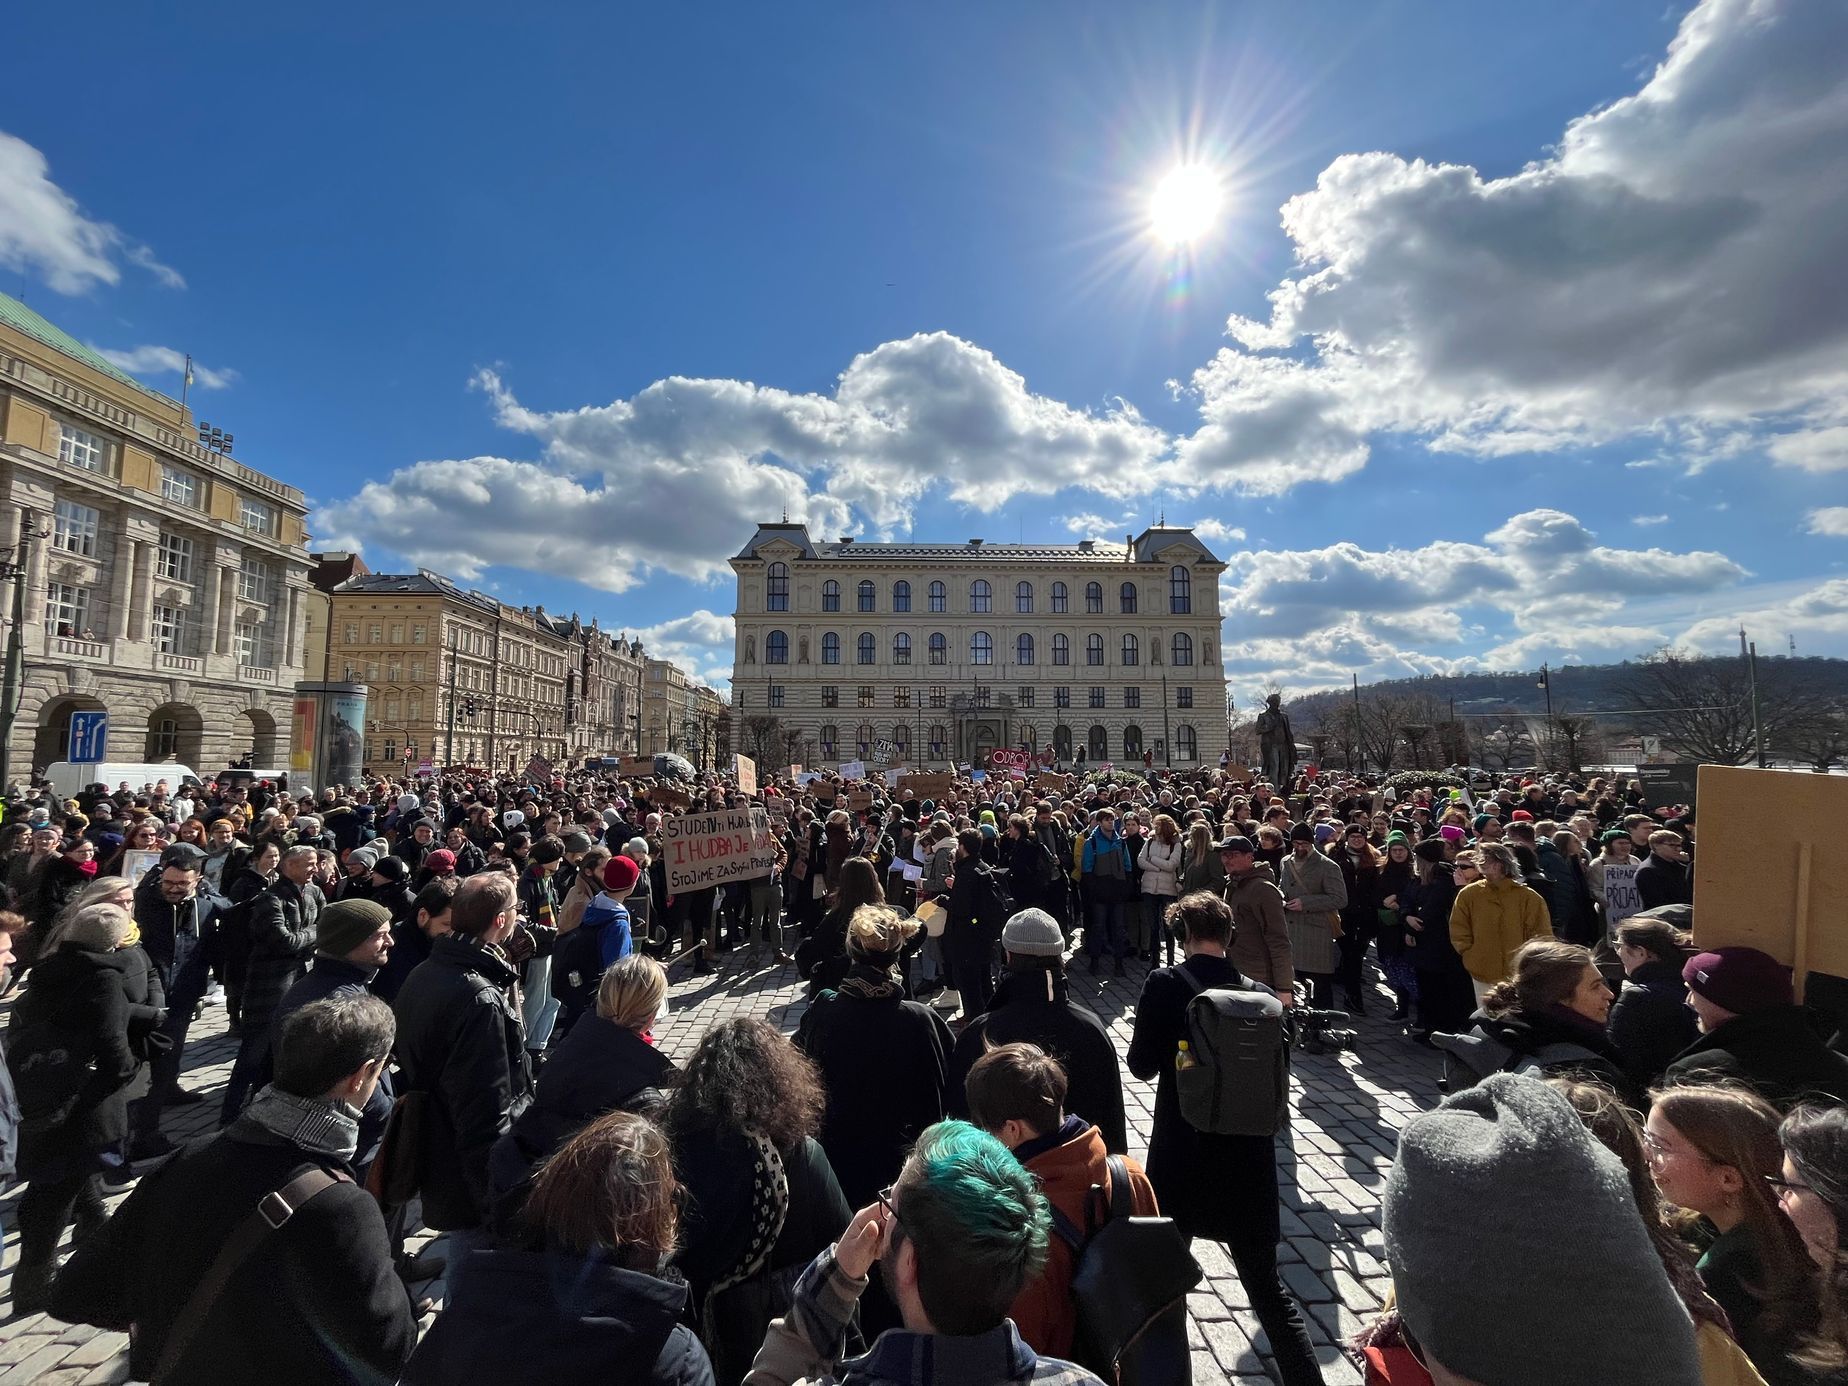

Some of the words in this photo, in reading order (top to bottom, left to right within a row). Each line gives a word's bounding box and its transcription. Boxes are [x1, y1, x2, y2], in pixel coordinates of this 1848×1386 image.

[672, 841, 685, 865] I
[689, 836, 733, 862] HUDBA
[717, 865, 730, 879] ZA
